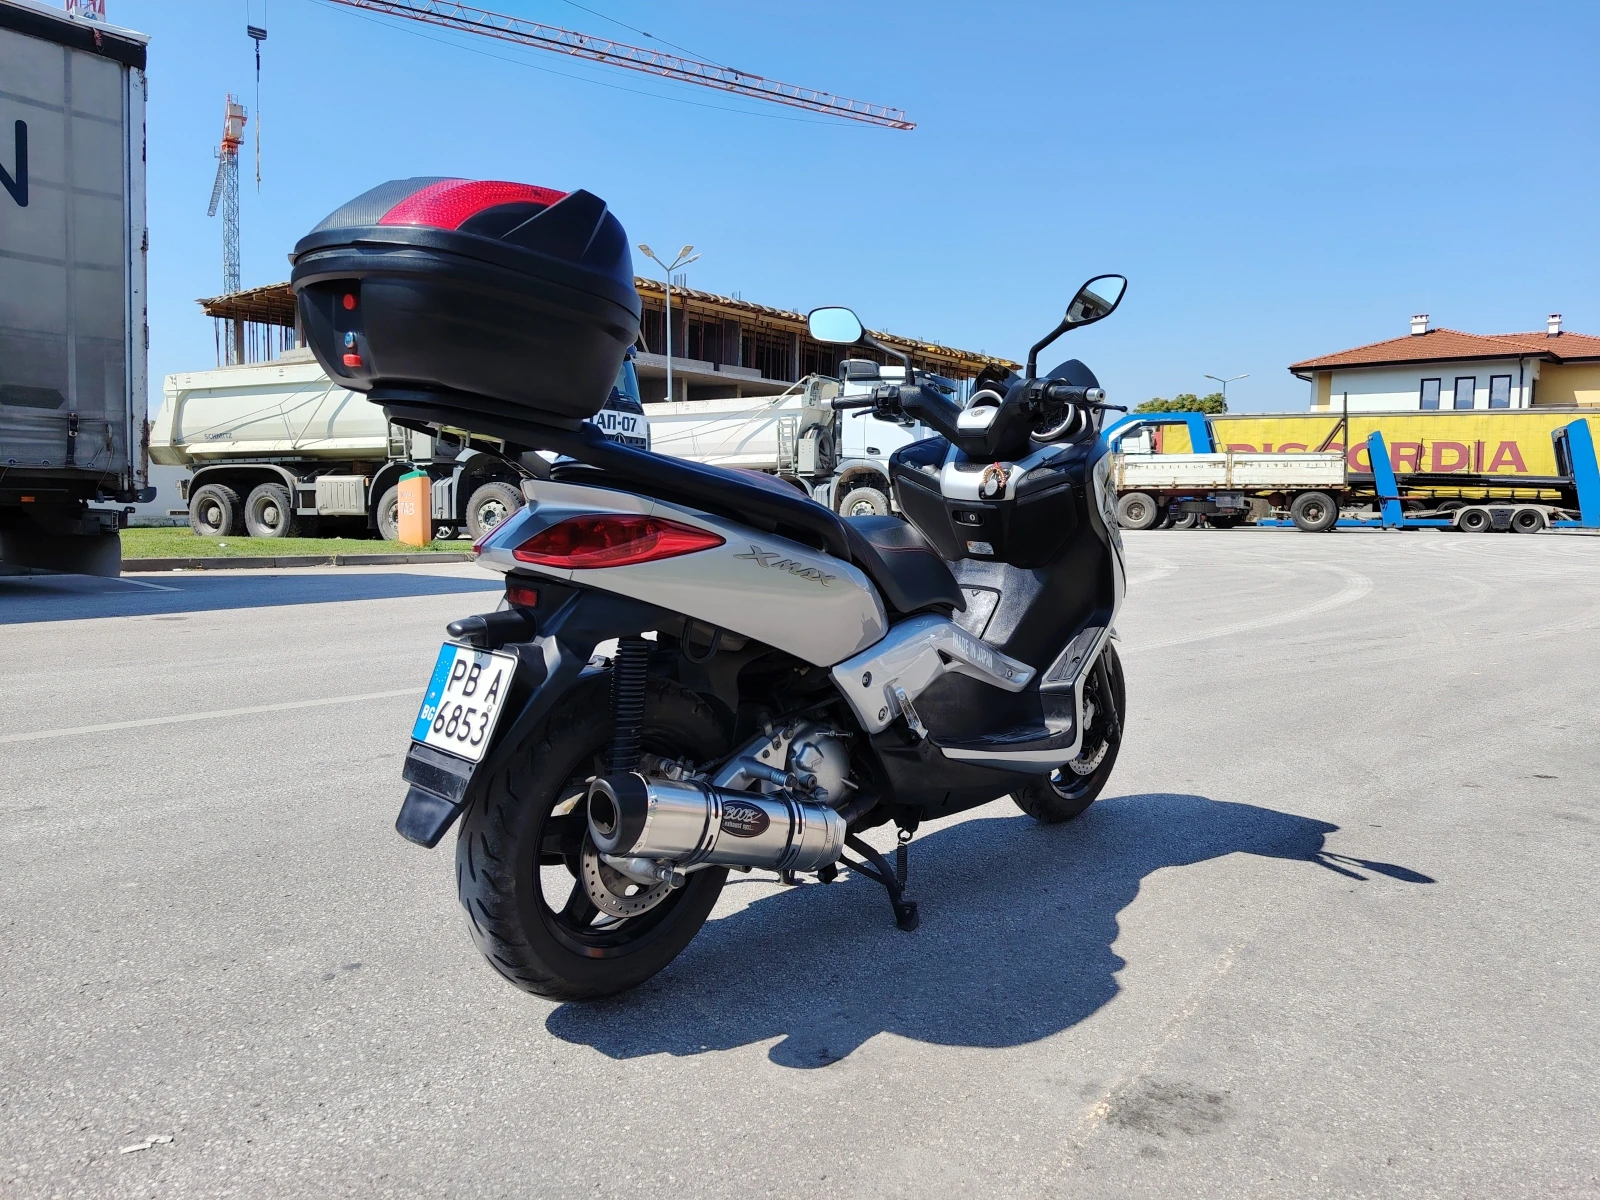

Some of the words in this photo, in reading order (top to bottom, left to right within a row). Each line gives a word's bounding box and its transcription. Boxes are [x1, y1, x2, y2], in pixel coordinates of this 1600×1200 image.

[589, 413, 637, 432] АП-07
[952, 631, 969, 655] MADE
[969, 641, 977, 659] IN
[977, 647, 992, 668] JAPAN
[447, 658, 482, 697] PB
[484, 669, 502, 705] A
[421, 704, 436, 720] BG
[433, 701, 490, 746] 6853
